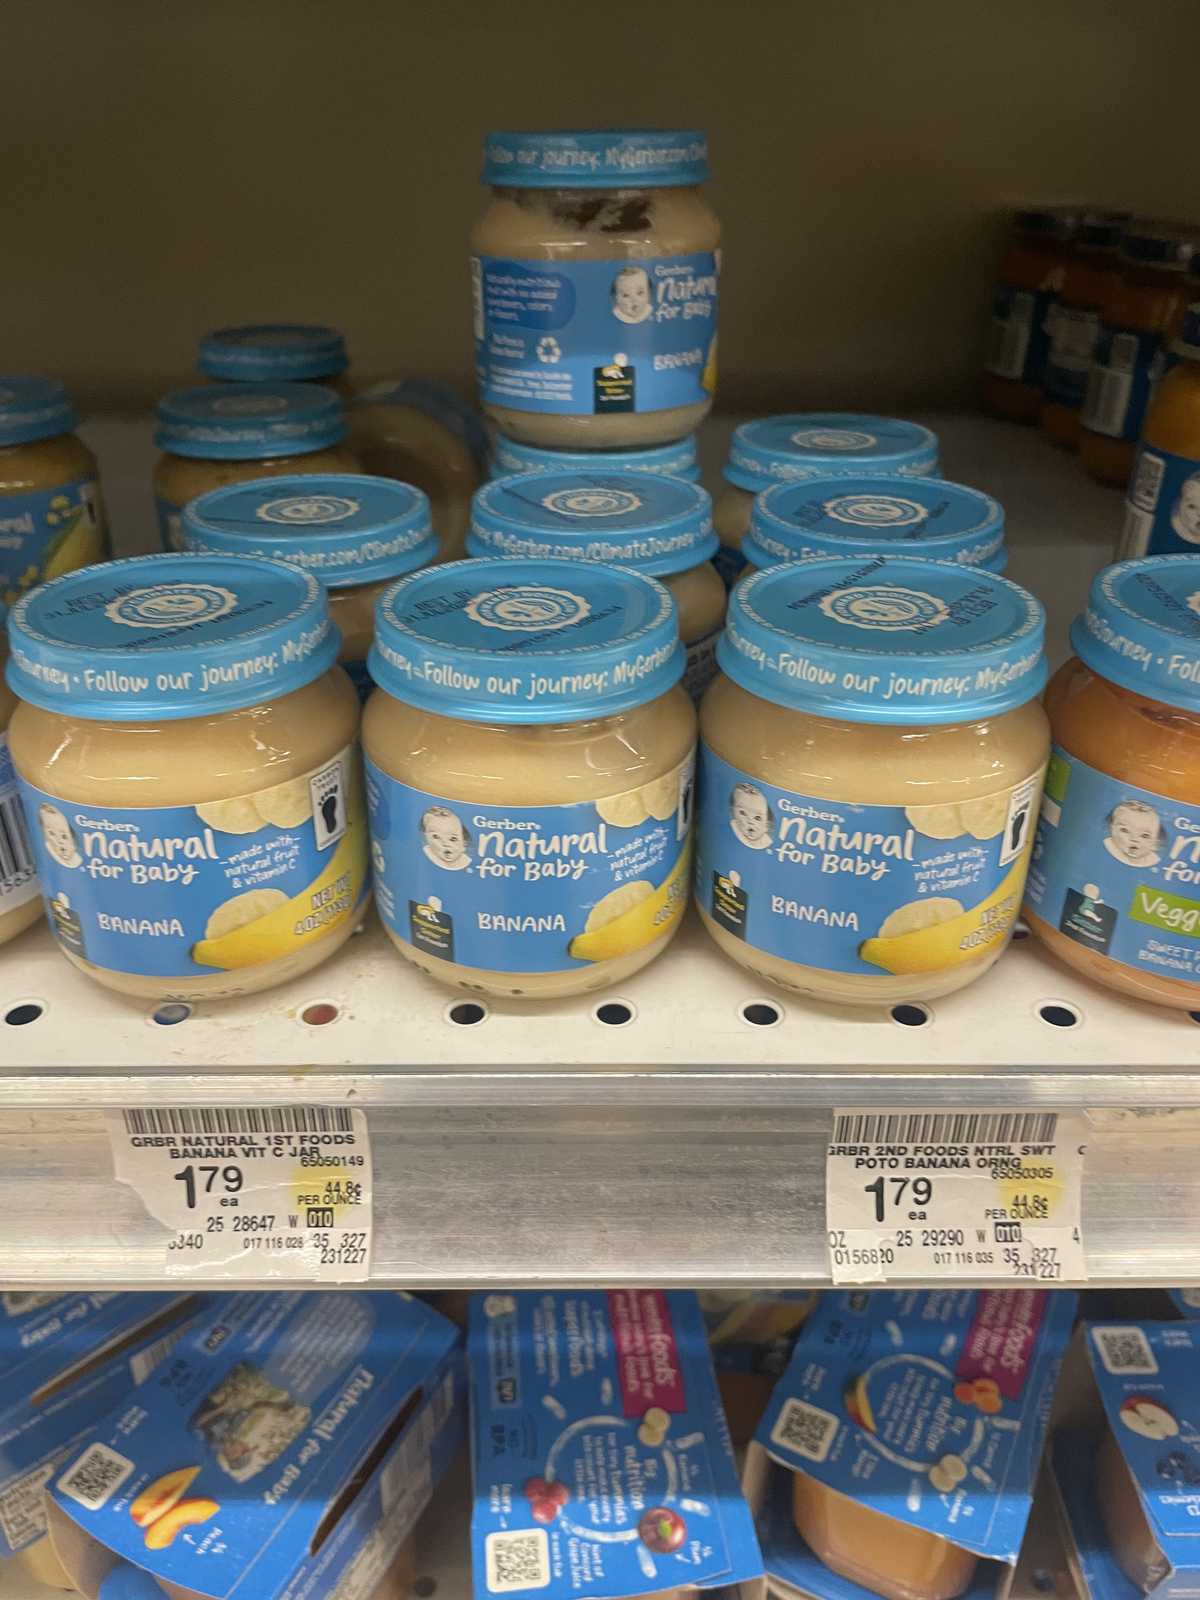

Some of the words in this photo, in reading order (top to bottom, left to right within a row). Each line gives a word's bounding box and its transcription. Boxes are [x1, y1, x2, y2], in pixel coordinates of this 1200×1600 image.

[83, 668, 149, 694] Follow
[156, 671, 193, 692] our
[423, 660, 480, 690] Follow
[486, 674, 522, 695] our
[776, 651, 837, 686] Follow
[842, 672, 880, 694] our
[777, 798, 841, 822] Gerber
[75, 814, 137, 832] Gerber
[472, 815, 537, 831] Gerber
[475, 857, 517, 879] for
[524, 858, 589, 881] Baby
[774, 841, 815, 865] for
[820, 853, 890, 881] Baby
[86, 857, 124, 879] for
[130, 862, 199, 885] Baby
[771, 894, 860, 932] BANANA
[97, 911, 185, 937] BANANA
[476, 911, 566, 933] BANANA
[131, 1136, 178, 1148] GRBR
[181, 1135, 258, 1147] NATURAL
[265, 1135, 294, 1146] 1ST
[300, 1134, 356, 1145] FOODS
[170, 1148, 238, 1159] BANANA
[242, 1147, 267, 1158] VIT
[273, 1147, 284, 1157] C
[289, 1146, 320, 1157] JAR
[875, 1146, 908, 1156] 2ND
[913, 1146, 969, 1156] FOODS
[974, 1146, 1015, 1156] NTRL
[1020, 1145, 1056, 1155] SWT
[300, 1155, 364, 1167] 65050149
[855, 1157, 899, 1169] POTO
[905, 1157, 971, 1169] BANANA
[975, 1157, 1022, 1168] ORNG
[991, 1167, 1054, 1180] 65050305
[219, 1197, 239, 1207] ea
[297, 1194, 320, 1205] PER
[323, 1193, 362, 1205] OUNCE
[206, 1216, 224, 1232] 25
[232, 1215, 276, 1232] 28647
[288, 1214, 299, 1229] W
[307, 1209, 333, 1227] 010
[908, 1209, 927, 1220] ea
[985, 1208, 1007, 1219] PER
[243, 1237, 262, 1249] 017
[265, 1237, 283, 1248] 116
[312, 1233, 329, 1248] 35
[340, 1233, 367, 1248] 327
[896, 1230, 914, 1247] 25
[921, 1229, 964, 1247] 29290
[976, 1229, 987, 1242] W
[320, 1248, 367, 1264] 231227
[934, 1253, 951, 1264] 017
[955, 1252, 974, 1264] 116
[1002, 1247, 1020, 1263] 35
